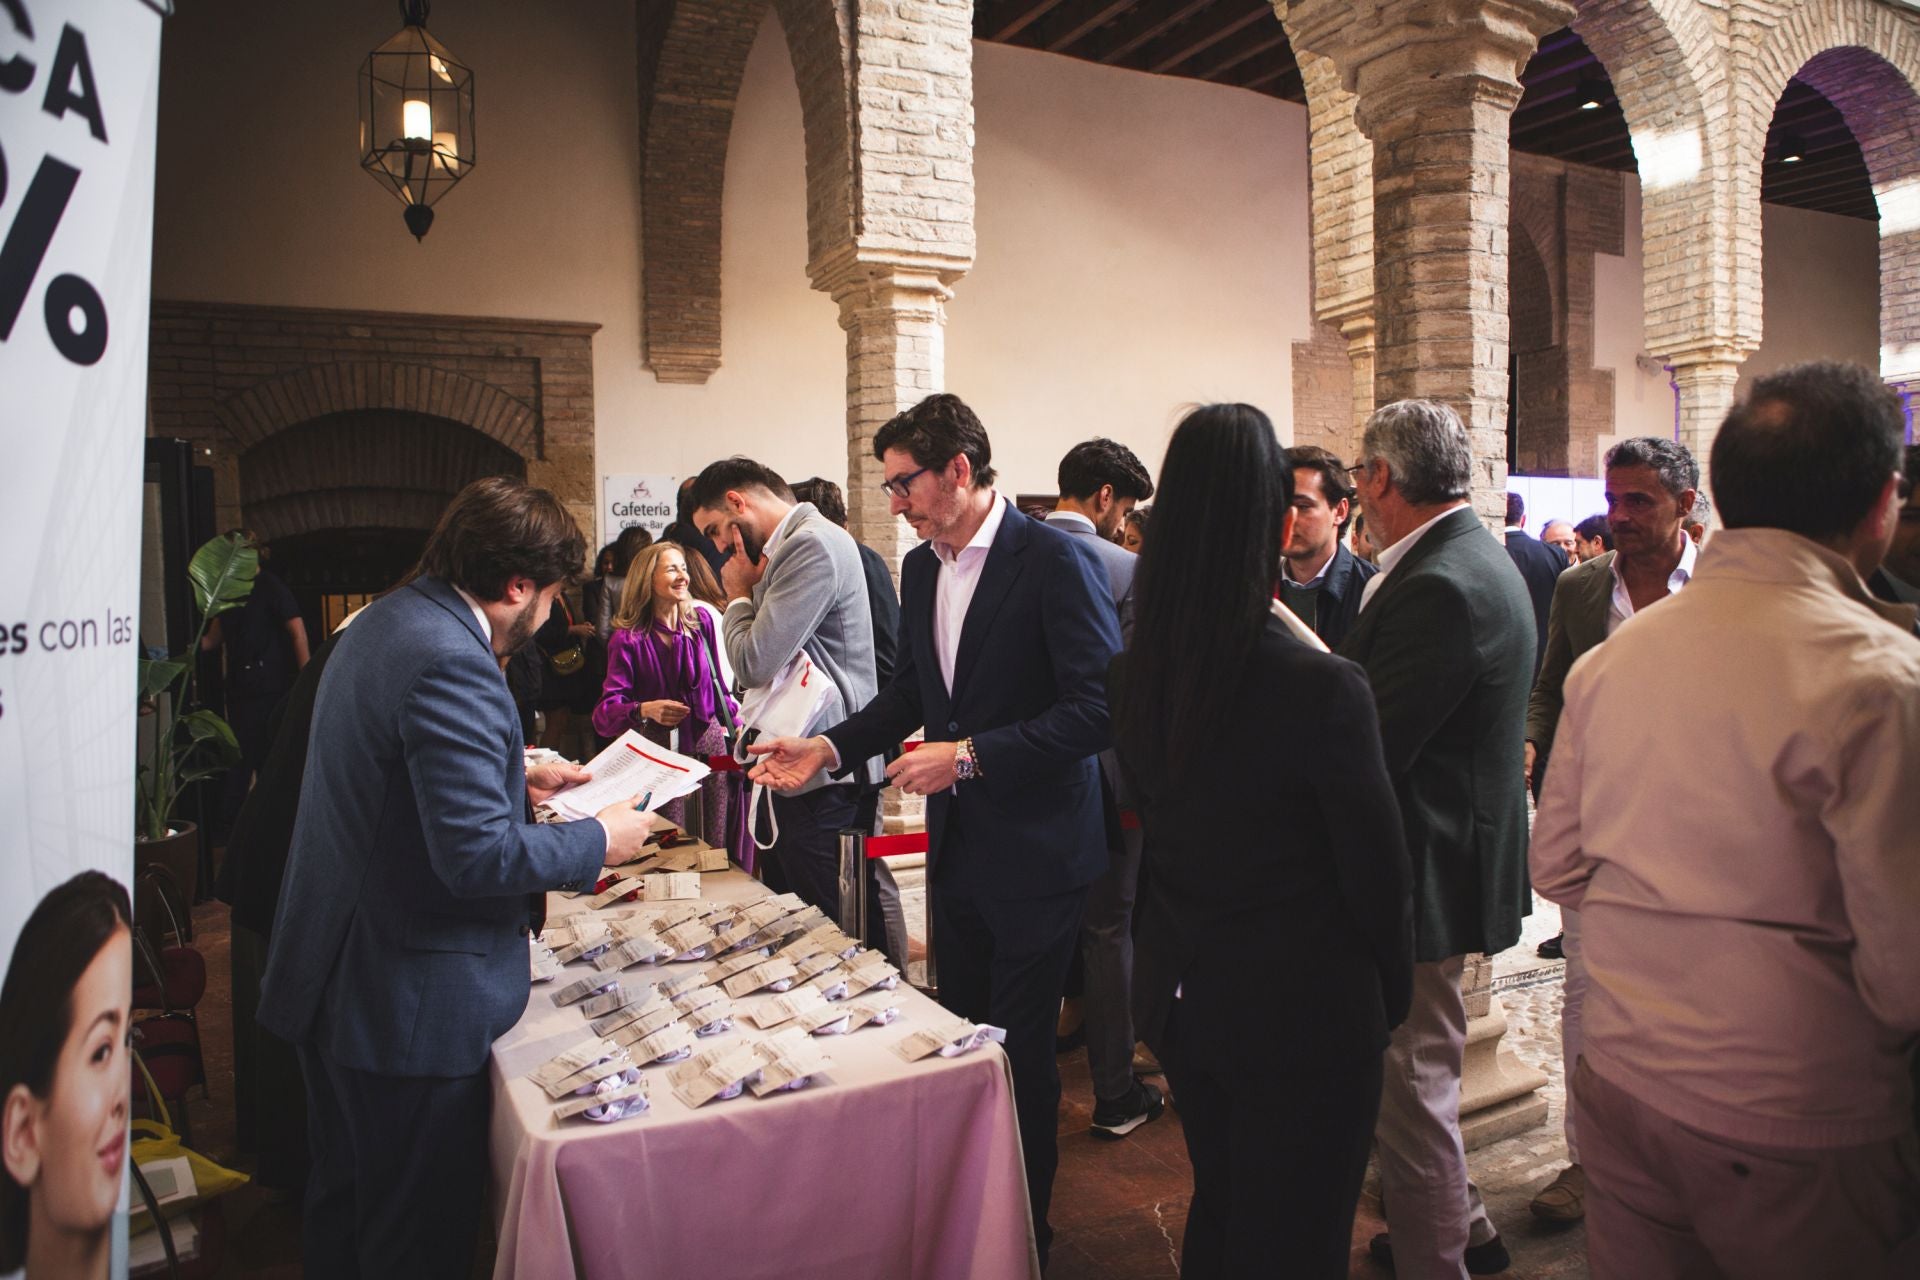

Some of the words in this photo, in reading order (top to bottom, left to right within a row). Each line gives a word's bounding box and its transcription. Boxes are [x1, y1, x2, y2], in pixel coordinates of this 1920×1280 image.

[612, 501, 670, 516] Cafetería
[40, 619, 97, 652] con
[107, 607, 132, 645] las
